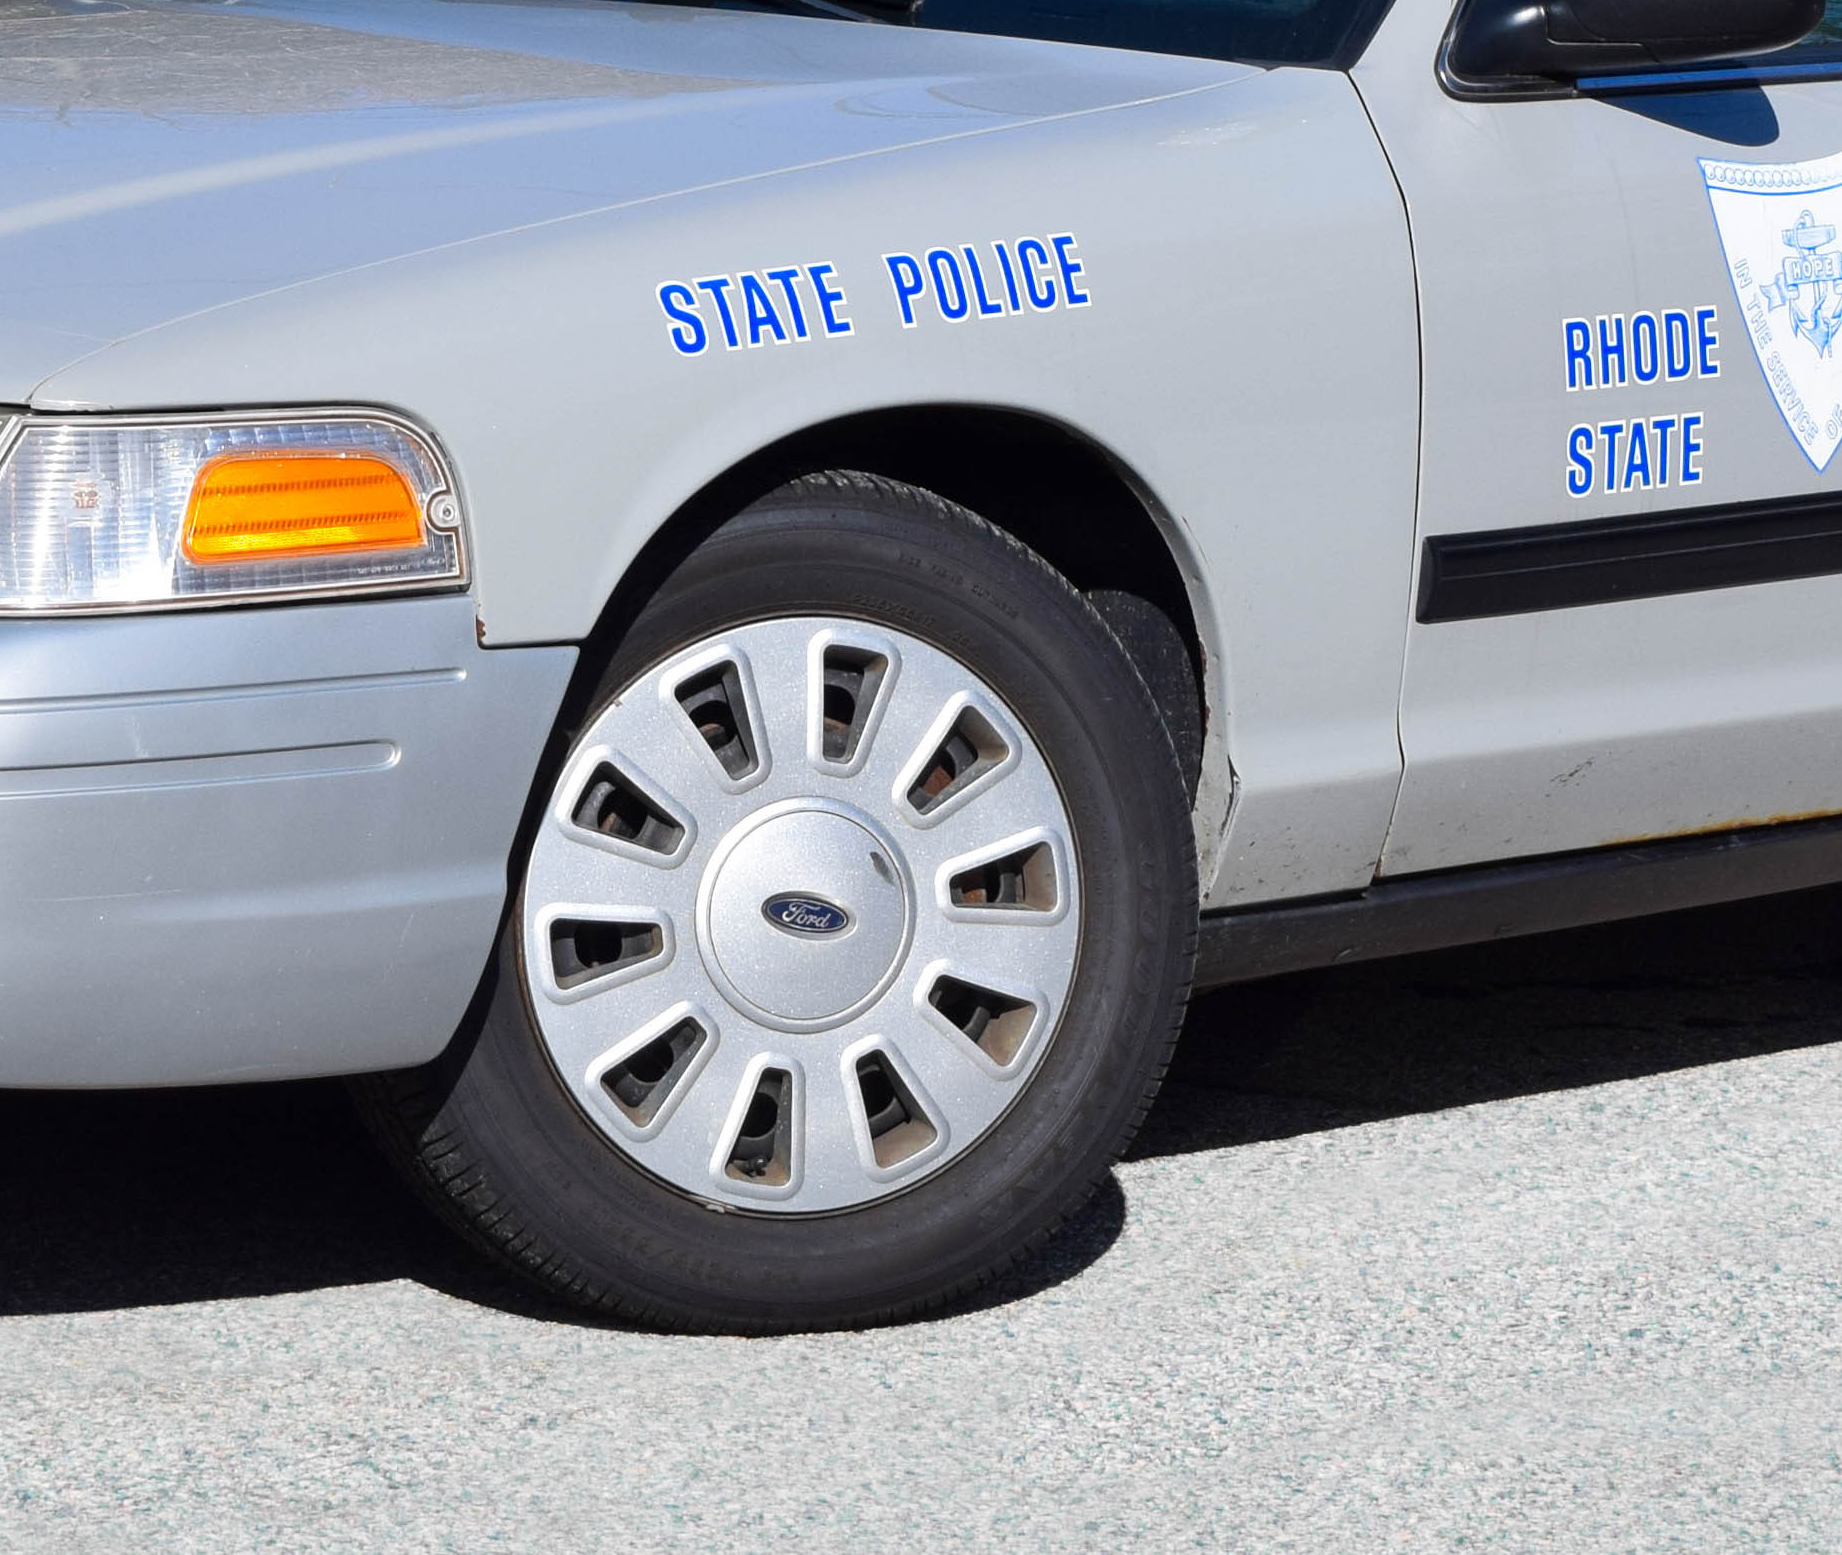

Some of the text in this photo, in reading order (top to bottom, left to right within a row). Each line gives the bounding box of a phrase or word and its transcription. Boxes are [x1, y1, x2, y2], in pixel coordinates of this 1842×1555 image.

[657, 233, 1092, 356] STATE POLICE
[1791, 257, 1835, 281] HOPE
[1564, 307, 1719, 390] RHODE
[1734, 258, 1753, 289] IN
[1746, 293, 1773, 350] THE
[1766, 350, 1819, 446] SERVICE
[1566, 413, 1704, 497] STATE
[781, 901, 832, 929] Ford
